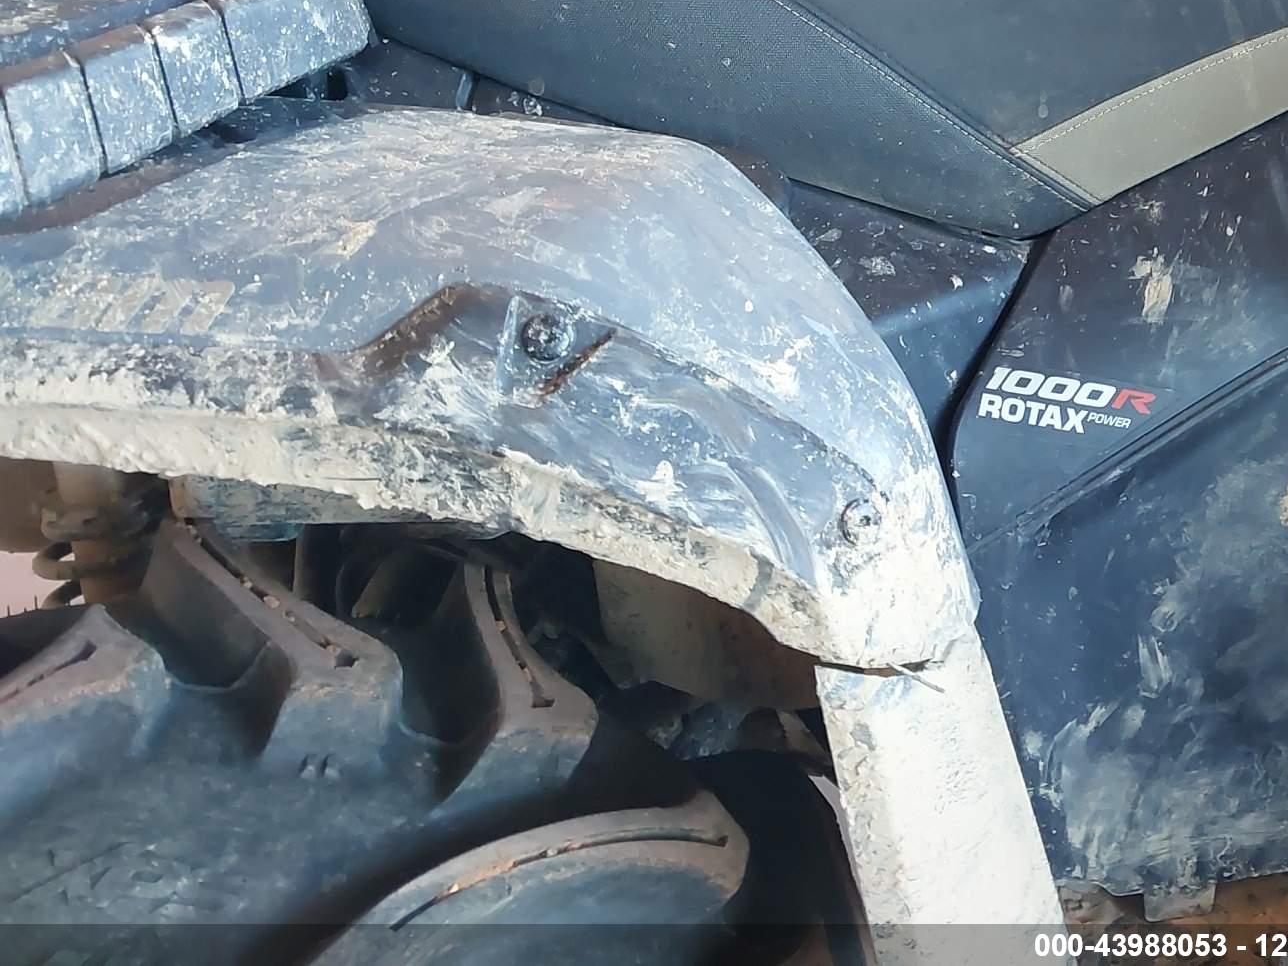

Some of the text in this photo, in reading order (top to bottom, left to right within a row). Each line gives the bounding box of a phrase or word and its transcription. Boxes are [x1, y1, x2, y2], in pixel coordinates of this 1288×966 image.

[986, 366, 1156, 415] 1000R
[978, 393, 1132, 435] ROTAX POWER
